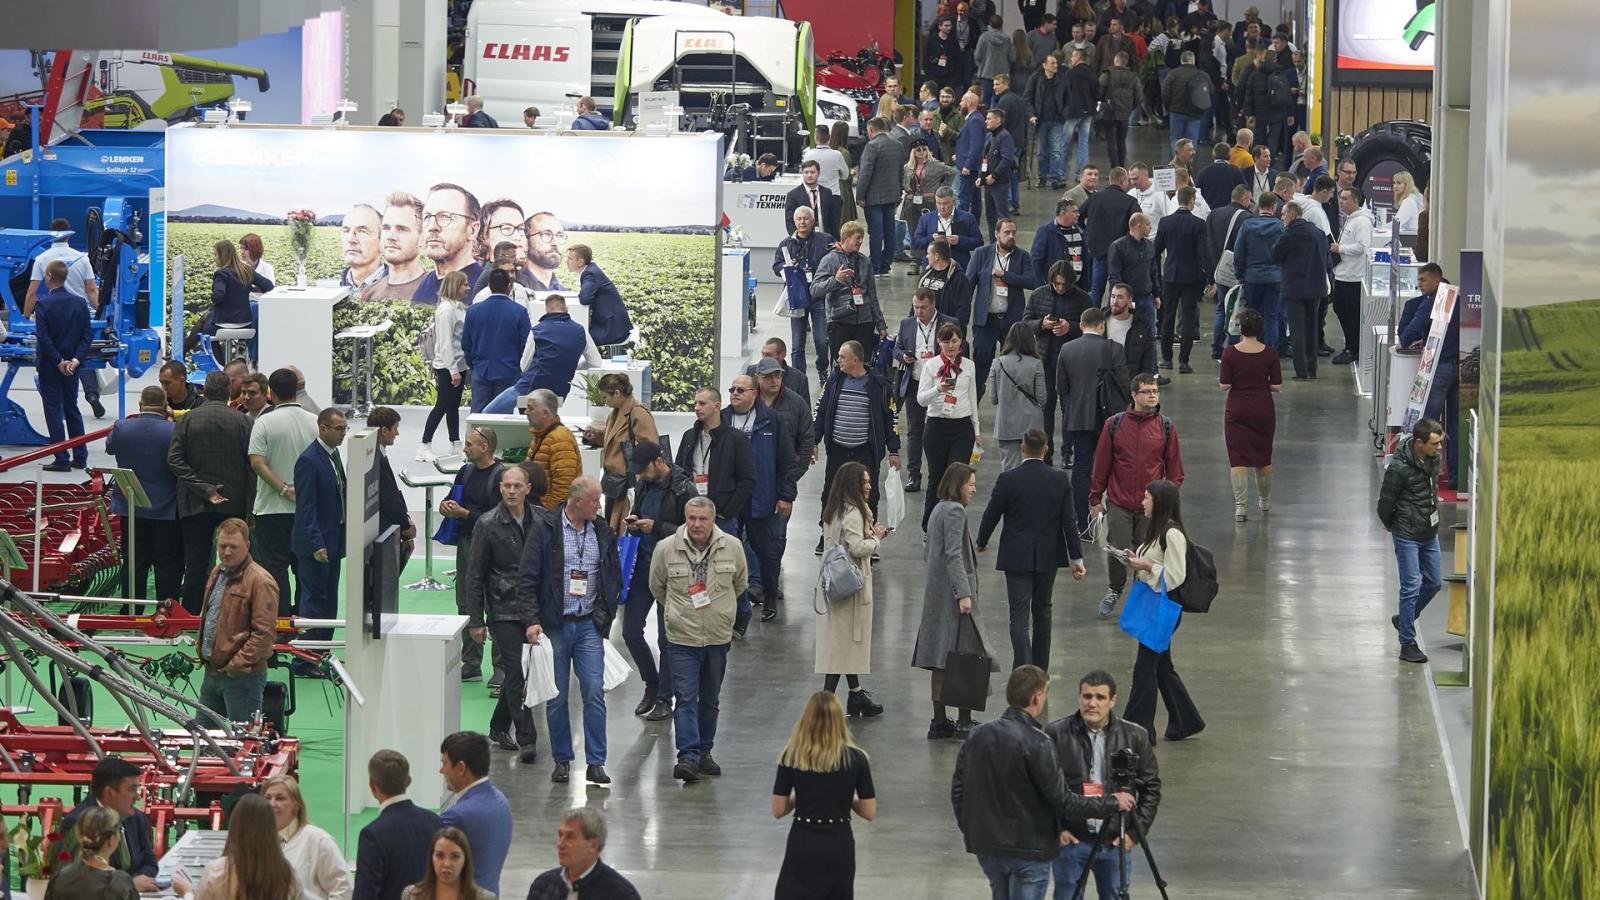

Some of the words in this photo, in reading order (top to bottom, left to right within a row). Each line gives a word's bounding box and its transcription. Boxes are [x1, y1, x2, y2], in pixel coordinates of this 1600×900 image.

[142, 52, 169, 62] CLAAS
[483, 43, 570, 63] CLAAS
[109, 155, 144, 163] LEMKEN
